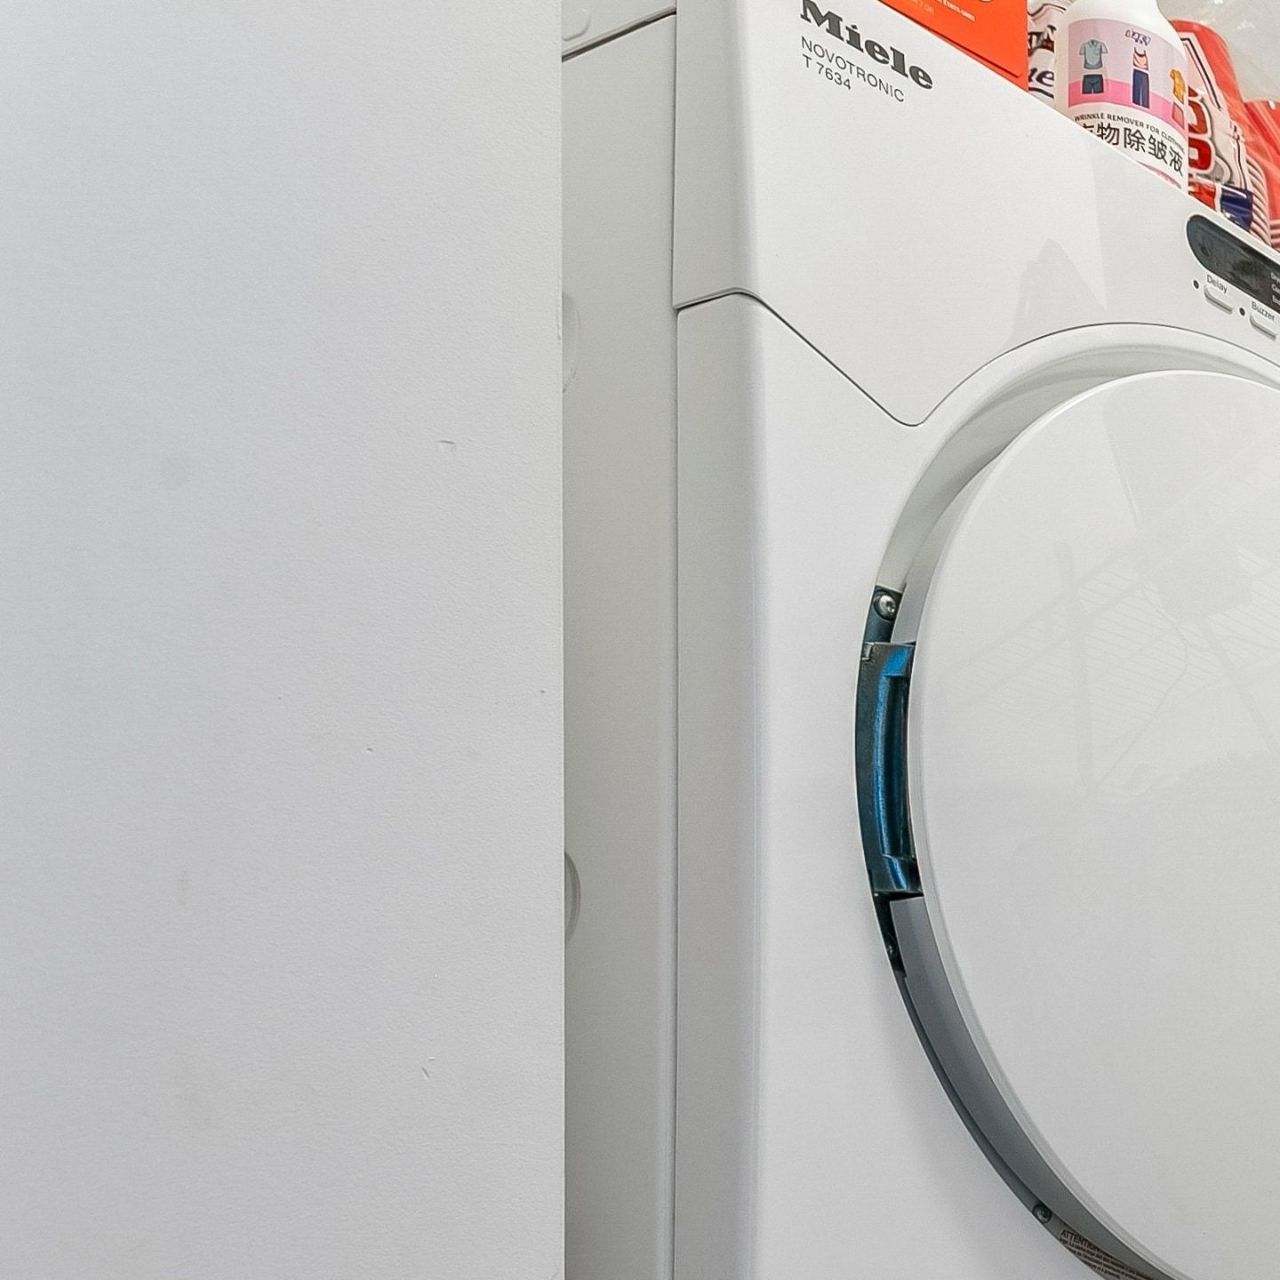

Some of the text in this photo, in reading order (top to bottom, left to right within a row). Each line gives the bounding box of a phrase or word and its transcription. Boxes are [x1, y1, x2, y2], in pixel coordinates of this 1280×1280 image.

[800, 0, 933, 90] Miele
[801, 36, 905, 102] NOVOTRONIC
[802, 54, 851, 90] T 7634
[1074, 112, 1105, 122] WRINKLE
[1107, 113, 1144, 128] REMOVER
[1146, 124, 1160, 134] FOR
[1206, 274, 1228, 294] Delay
[1251, 301, 1276, 321] Buzzer
